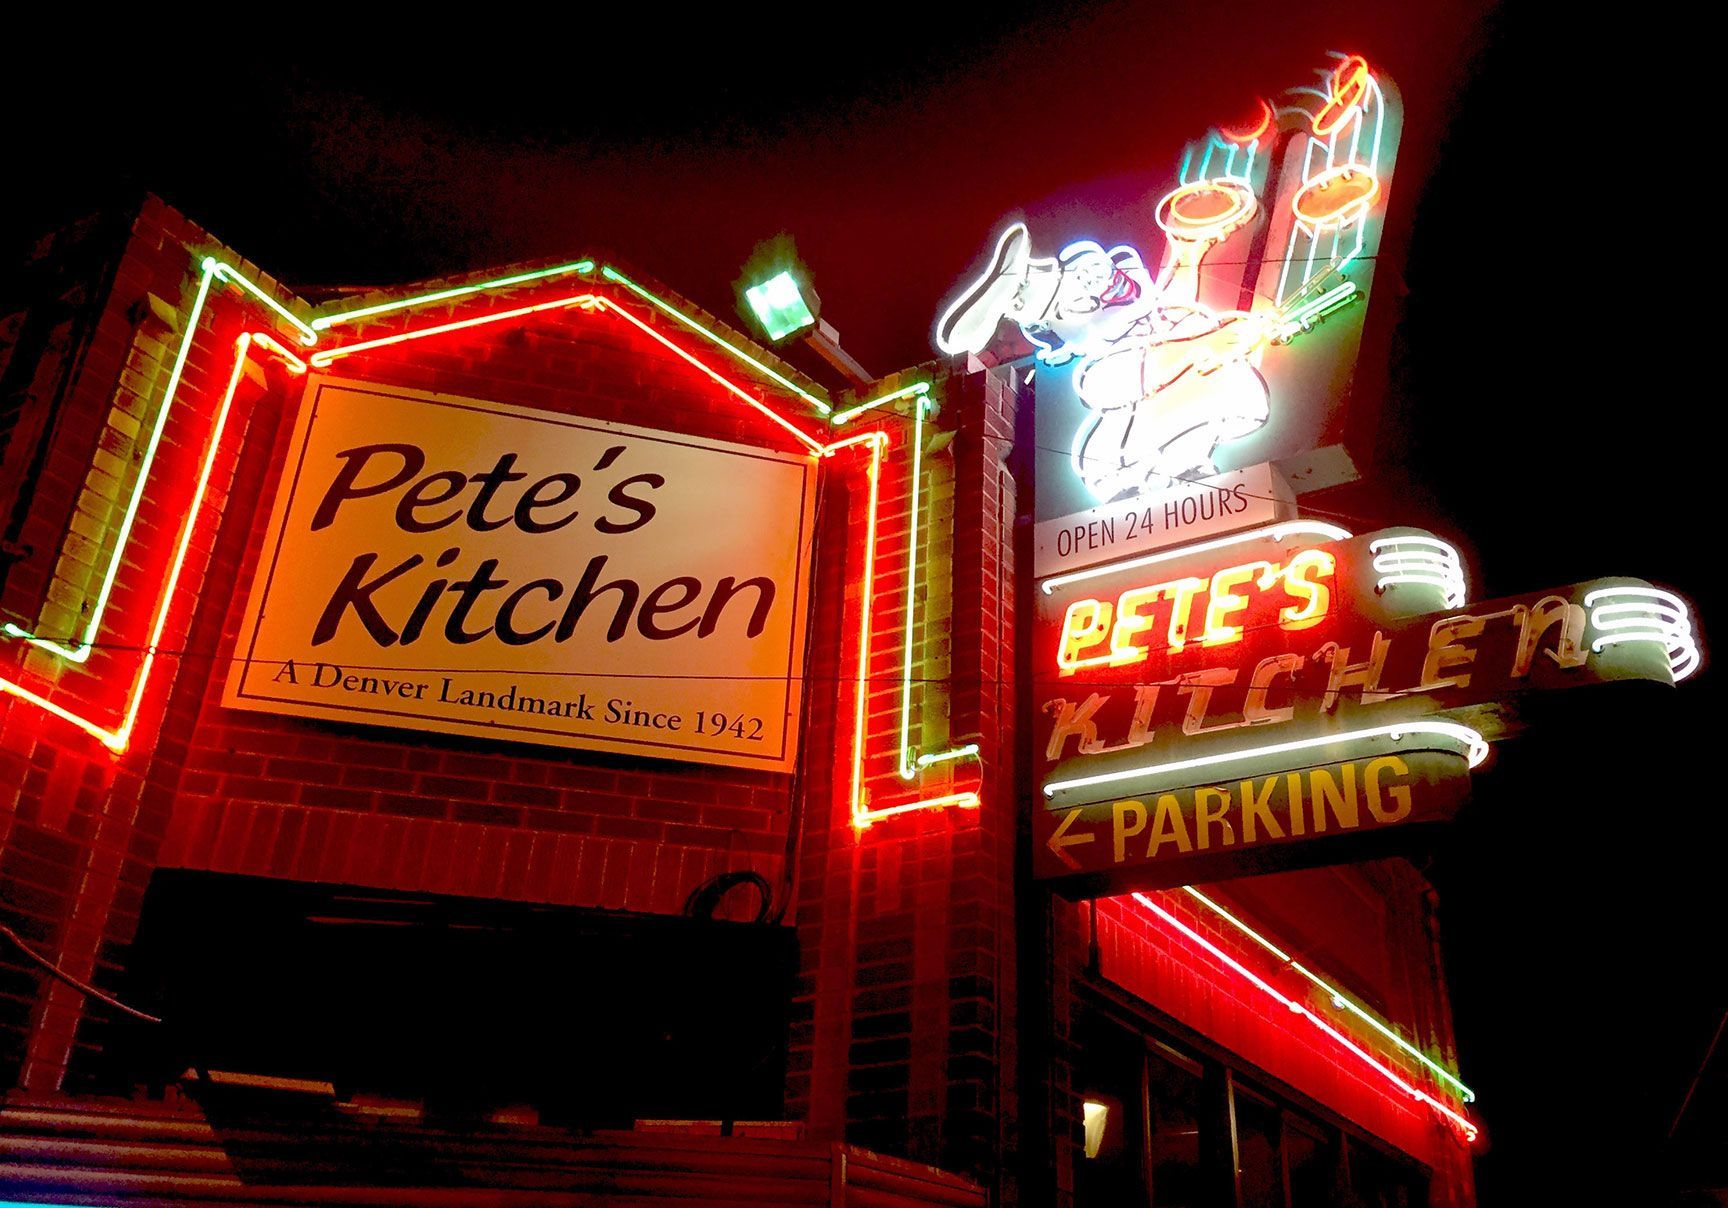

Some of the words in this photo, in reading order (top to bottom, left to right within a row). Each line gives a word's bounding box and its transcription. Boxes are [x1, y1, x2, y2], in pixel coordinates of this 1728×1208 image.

[310, 443, 665, 534] Pete's
[1057, 517, 1116, 558] OPEN
[1125, 503, 1155, 539] 24
[1164, 483, 1249, 531] HOURS
[311, 547, 776, 648] Kitchen
[1057, 549, 1337, 678] PETE'S
[272, 659, 300, 685] A
[310, 662, 430, 701] Denver
[437, 677, 595, 721] Landmark
[604, 698, 682, 731] Since
[694, 711, 765, 741] 1942
[1112, 755, 1413, 864] PARKING
